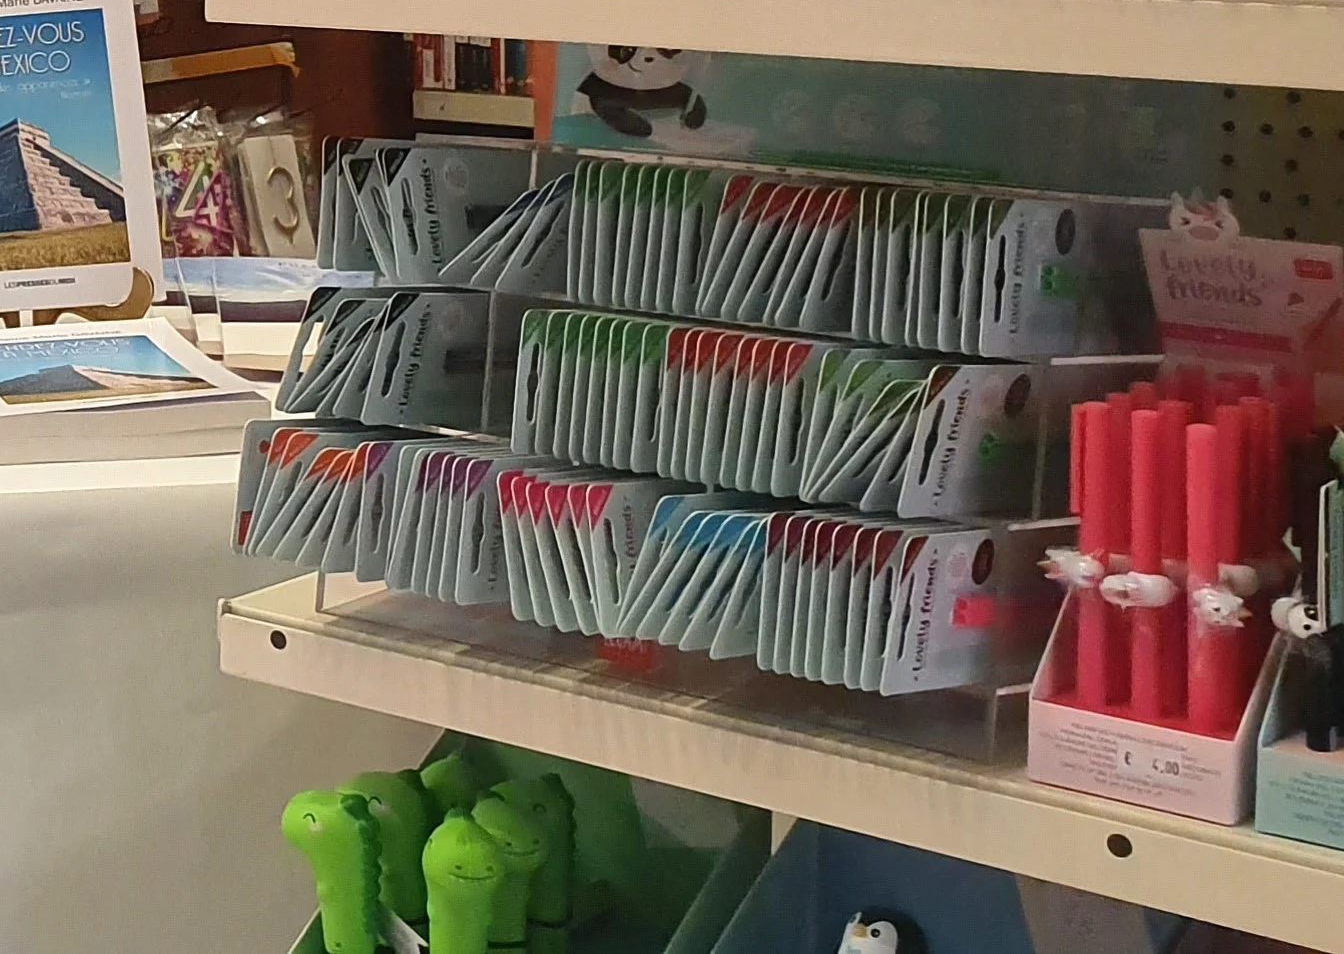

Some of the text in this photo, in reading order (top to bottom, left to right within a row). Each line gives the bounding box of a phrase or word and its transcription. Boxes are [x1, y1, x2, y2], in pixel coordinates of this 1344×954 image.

[1166, 275, 1263, 307] friends
[946, 387, 970, 442] friends
[922, 555, 939, 609] friends
[1124, 751, 1180, 777] € 4.00
